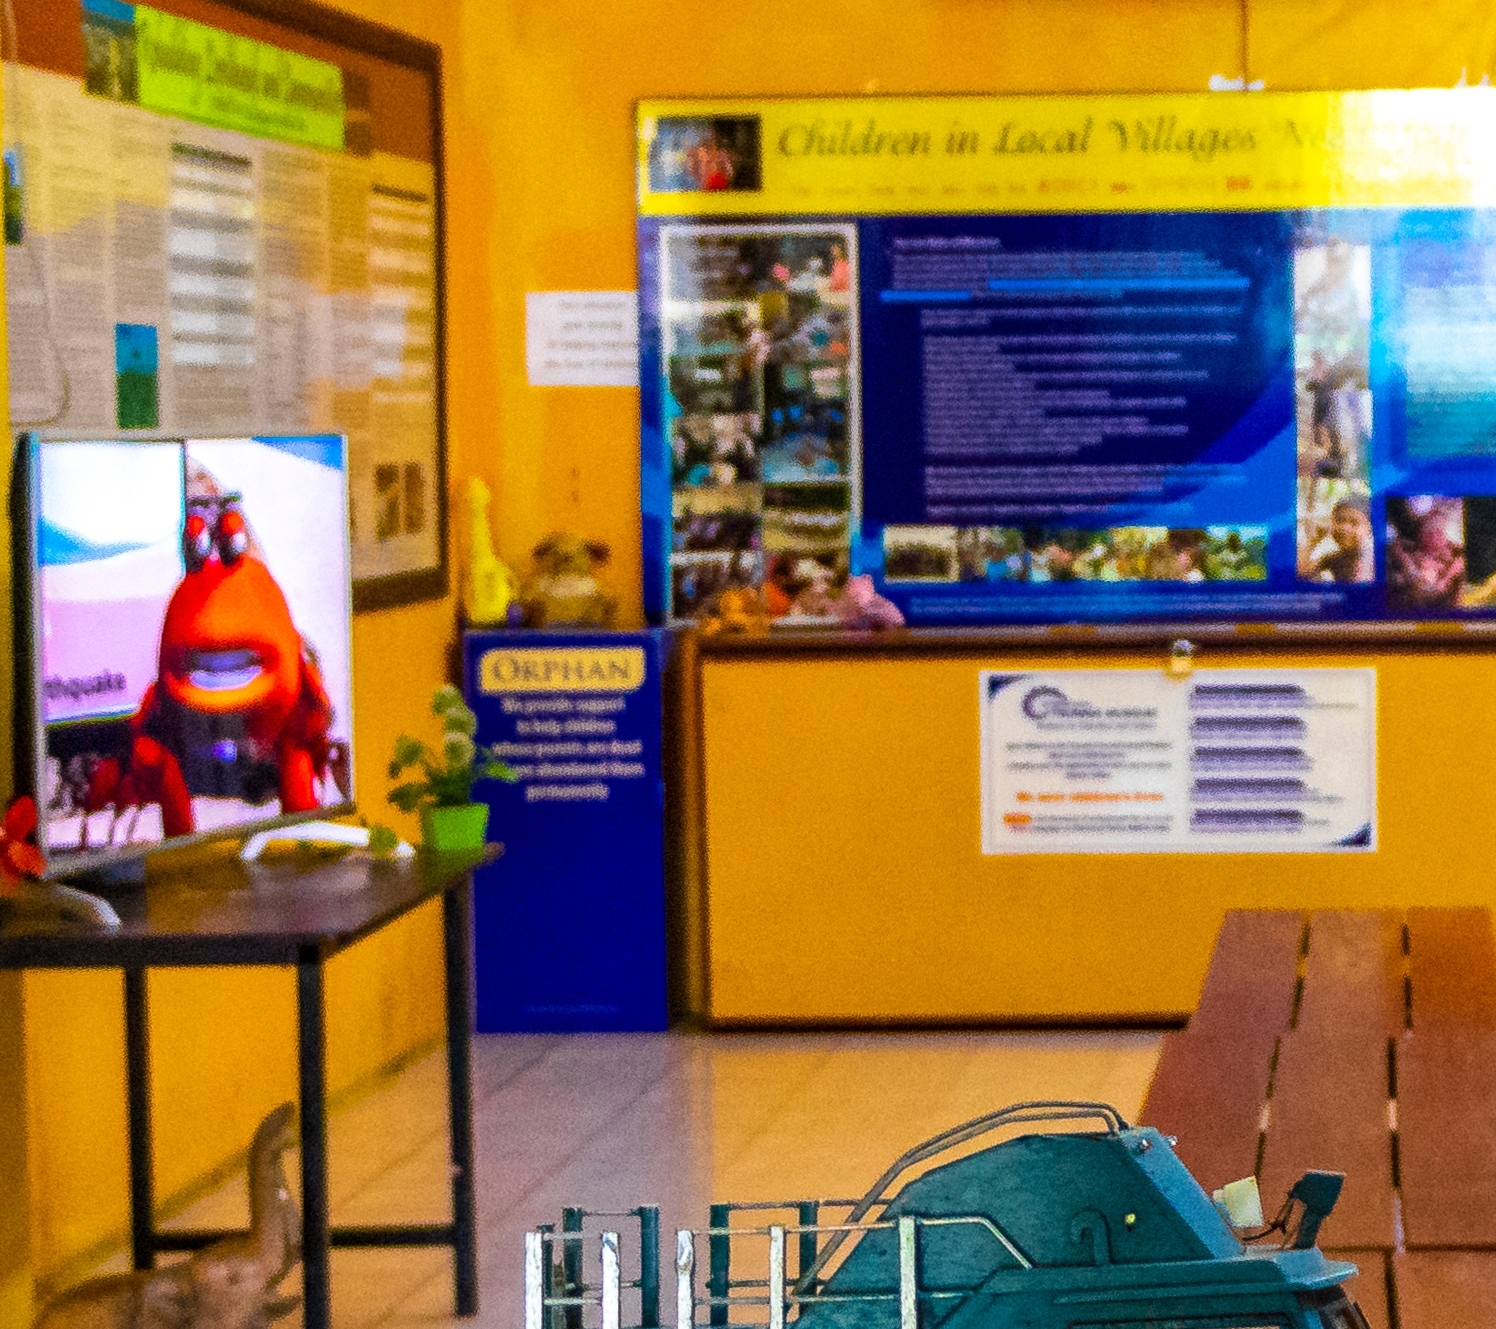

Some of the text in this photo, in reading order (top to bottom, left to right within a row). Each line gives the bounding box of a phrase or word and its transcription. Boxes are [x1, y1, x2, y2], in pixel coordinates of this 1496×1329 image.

[777, 117, 933, 158] Children
[945, 119, 980, 157] in
[993, 114, 1094, 157] Local
[1106, 115, 1258, 161] Villages
[491, 656, 631, 682] ORPHAN
